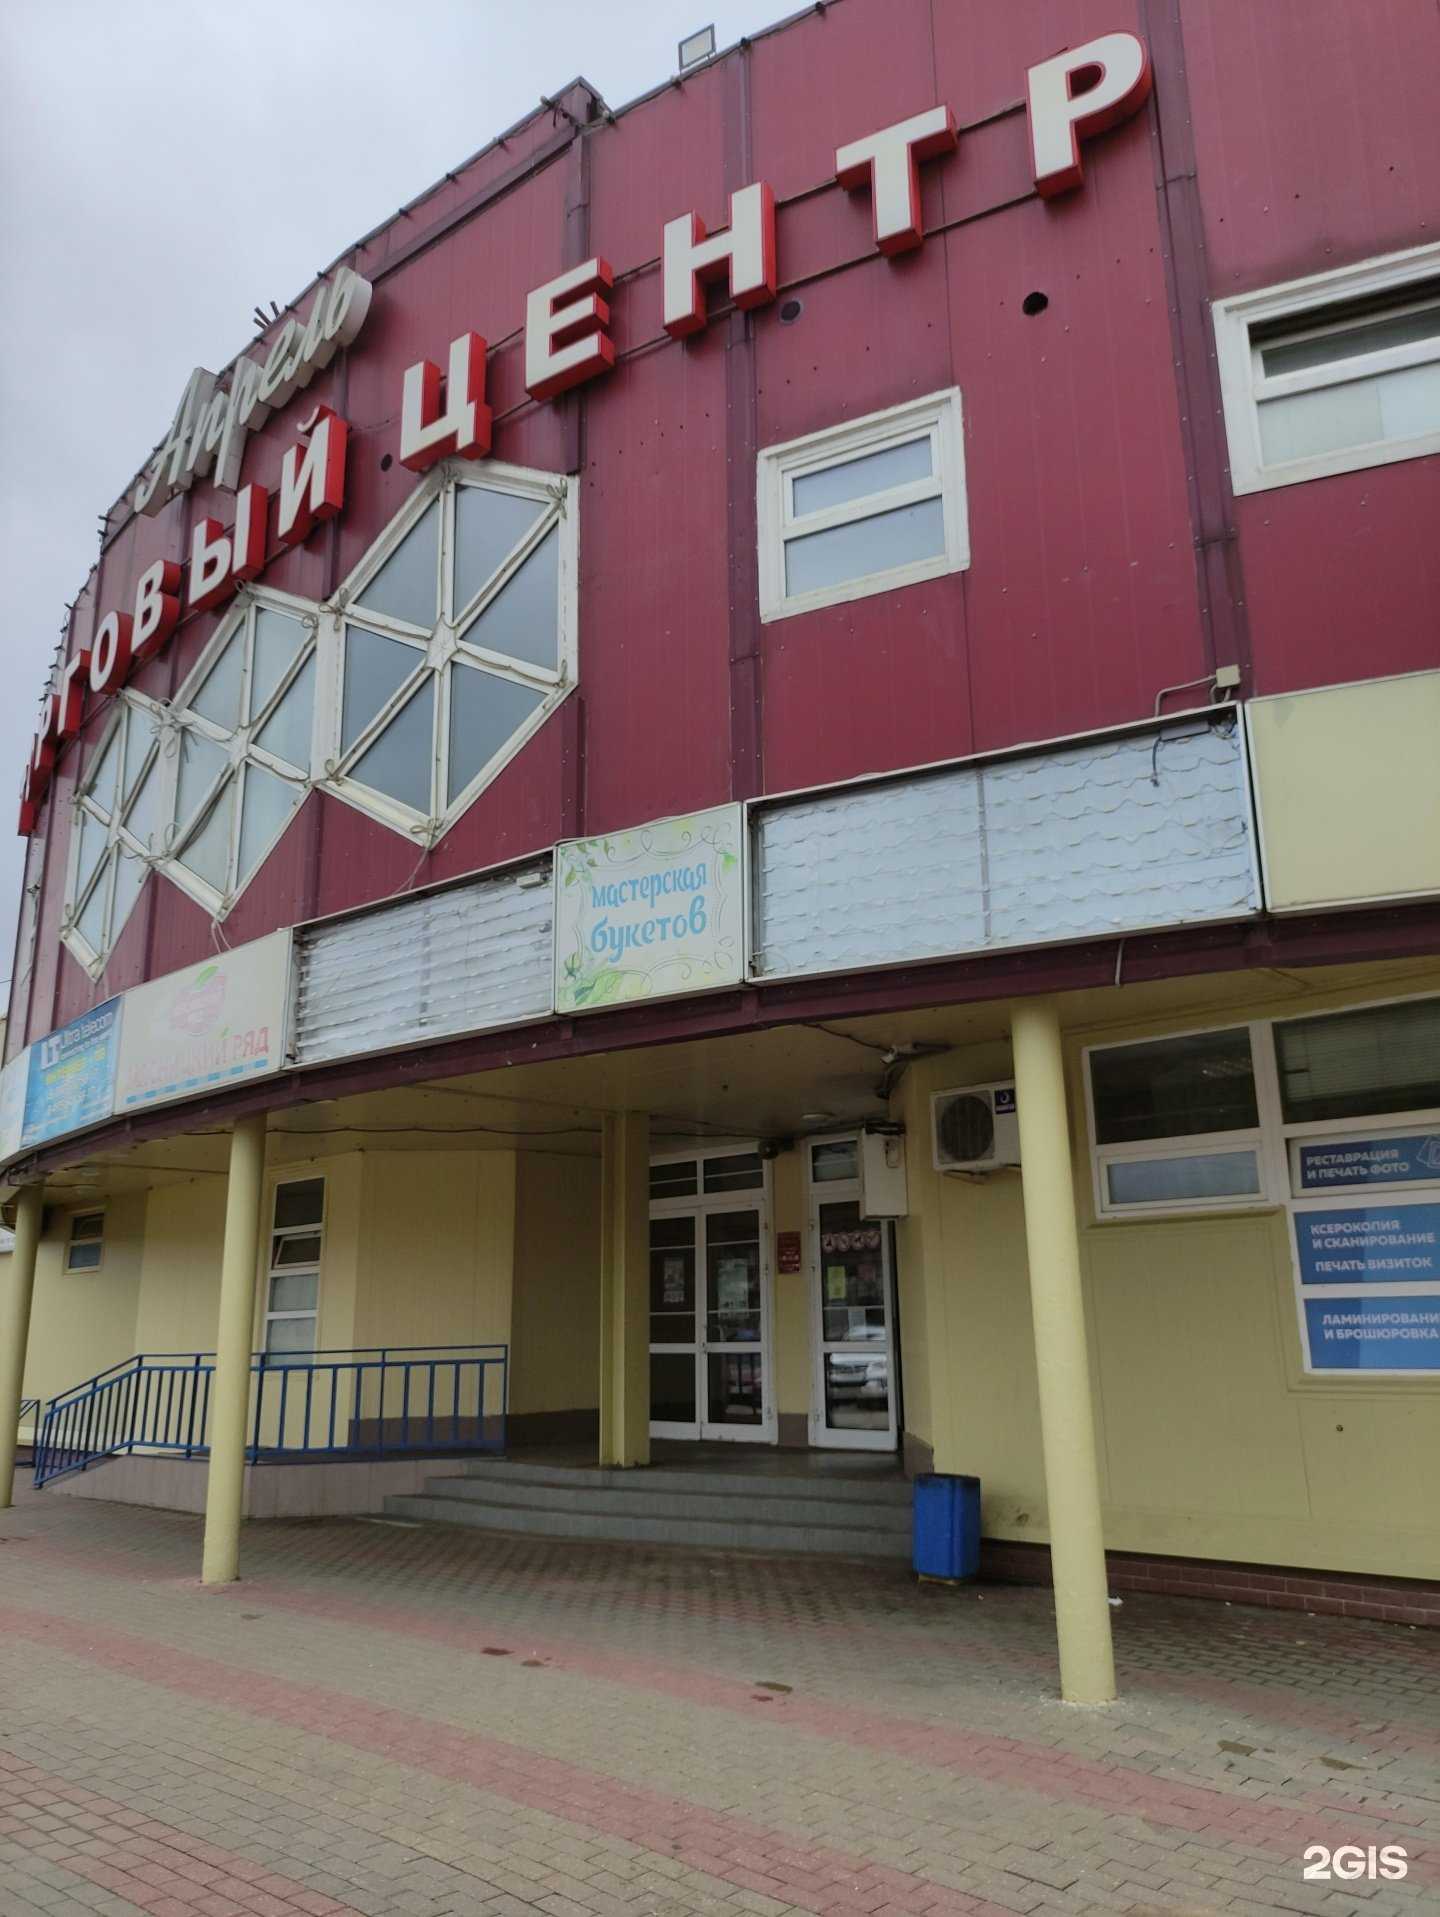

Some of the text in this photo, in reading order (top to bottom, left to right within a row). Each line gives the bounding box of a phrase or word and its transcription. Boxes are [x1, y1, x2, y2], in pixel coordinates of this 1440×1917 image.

[400, 31, 1153, 472] ЦЕНТР
[134, 266, 372, 517] Апрель
[592, 863, 707, 908] мастерская
[591, 895, 707, 963] букетов
[232, 1026, 270, 1061] РЯД
[1306, 1149, 1400, 1166] РЕСТАВРАЦИЯ
[1307, 1162, 1410, 1180] И ПЕЧАТЬ ФОТО
[1311, 1219, 1400, 1235] КСЕРОКОПИЯ
[1312, 1232, 1436, 1249] И СКАНИРОВАНИЕ
[1315, 1257, 1433, 1272] ПЕЧАТЬ ВИЗИТОК
[1322, 1313, 1440, 1326] ЛАМИНИРОВАНИ
[1324, 1327, 1439, 1340] И БРОШЮРОВКА
